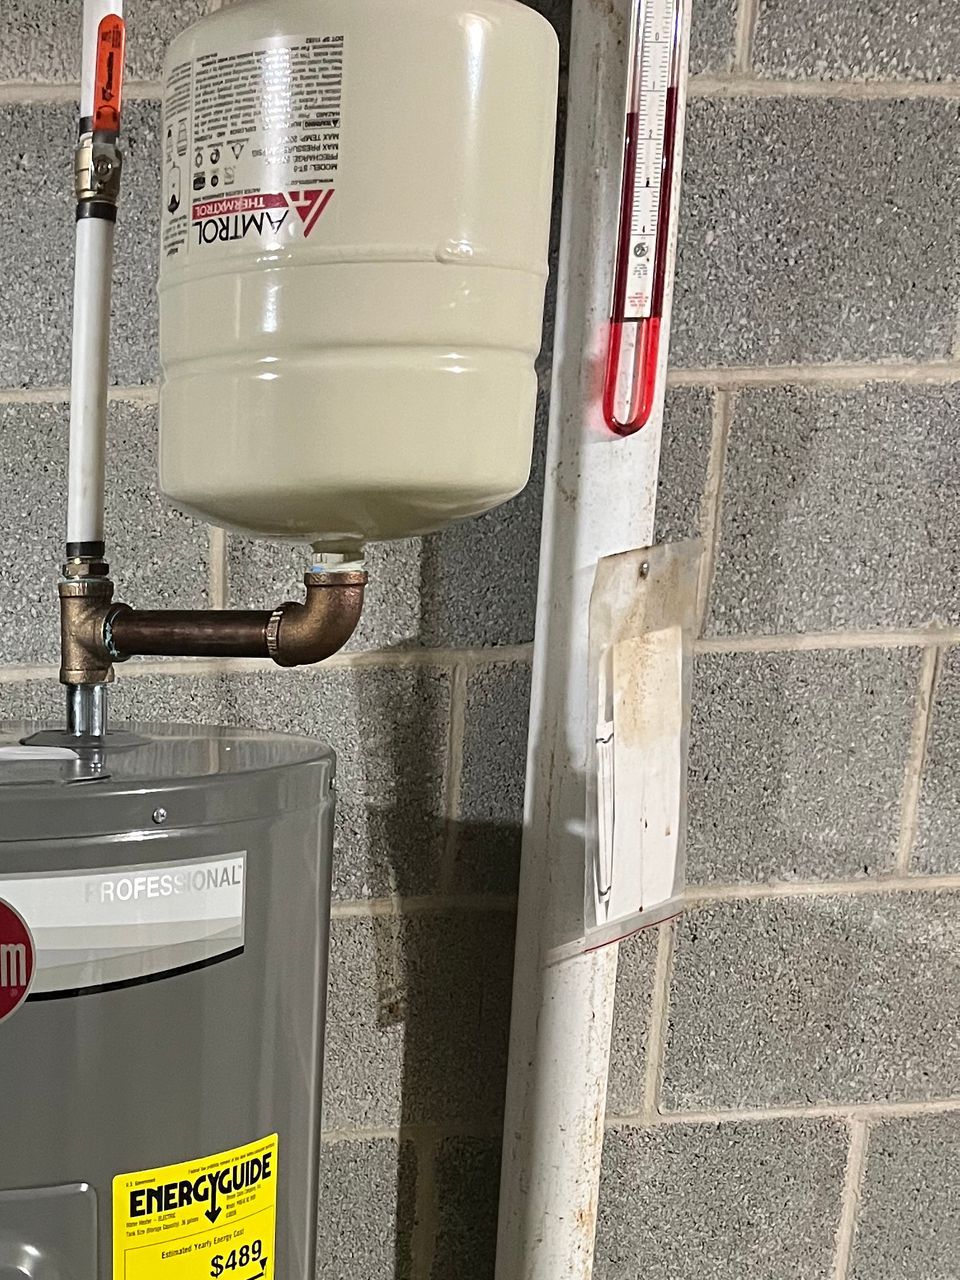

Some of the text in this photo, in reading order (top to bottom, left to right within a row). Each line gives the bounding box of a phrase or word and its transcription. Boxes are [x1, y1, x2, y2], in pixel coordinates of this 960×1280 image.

[322, 133, 339, 141] MAX
[192, 210, 288, 245] AMTROL
[130, 1152, 272, 1218] ENERGYGUIDE
[161, 1228, 244, 1259] Estimated Yearly Energy Cost
[210, 1239, 262, 1279] $489
